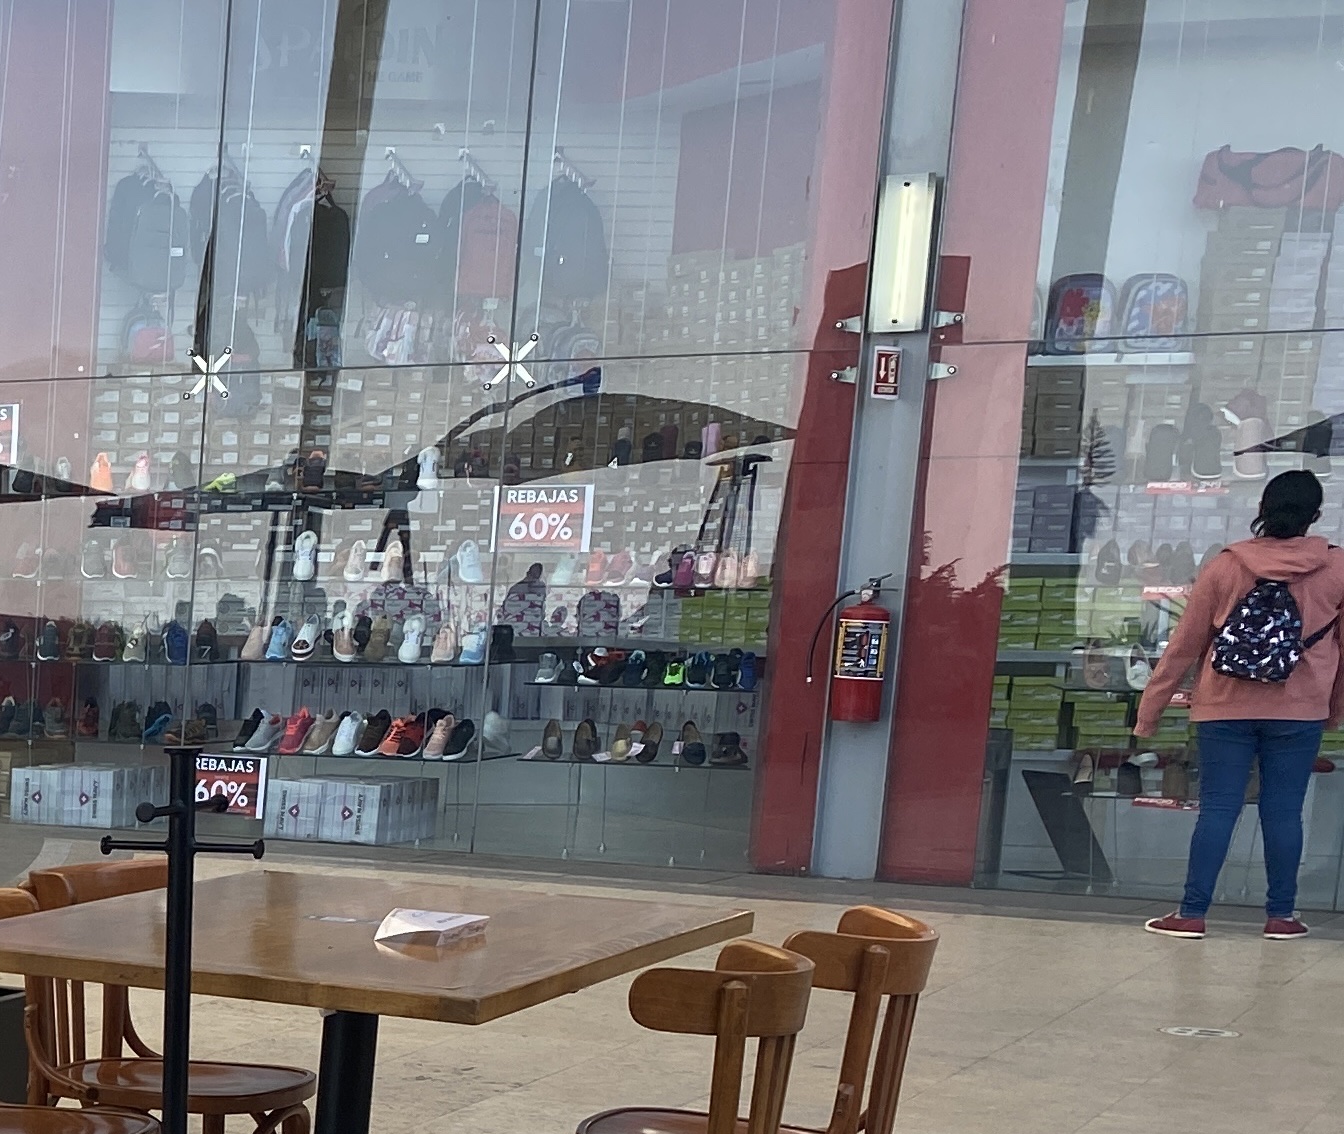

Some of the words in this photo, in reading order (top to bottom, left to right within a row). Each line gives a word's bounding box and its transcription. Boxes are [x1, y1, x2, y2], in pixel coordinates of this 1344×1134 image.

[507, 489, 579, 504] REBAJAS
[508, 512, 573, 541] 60%
[195, 779, 249, 807] 60%
